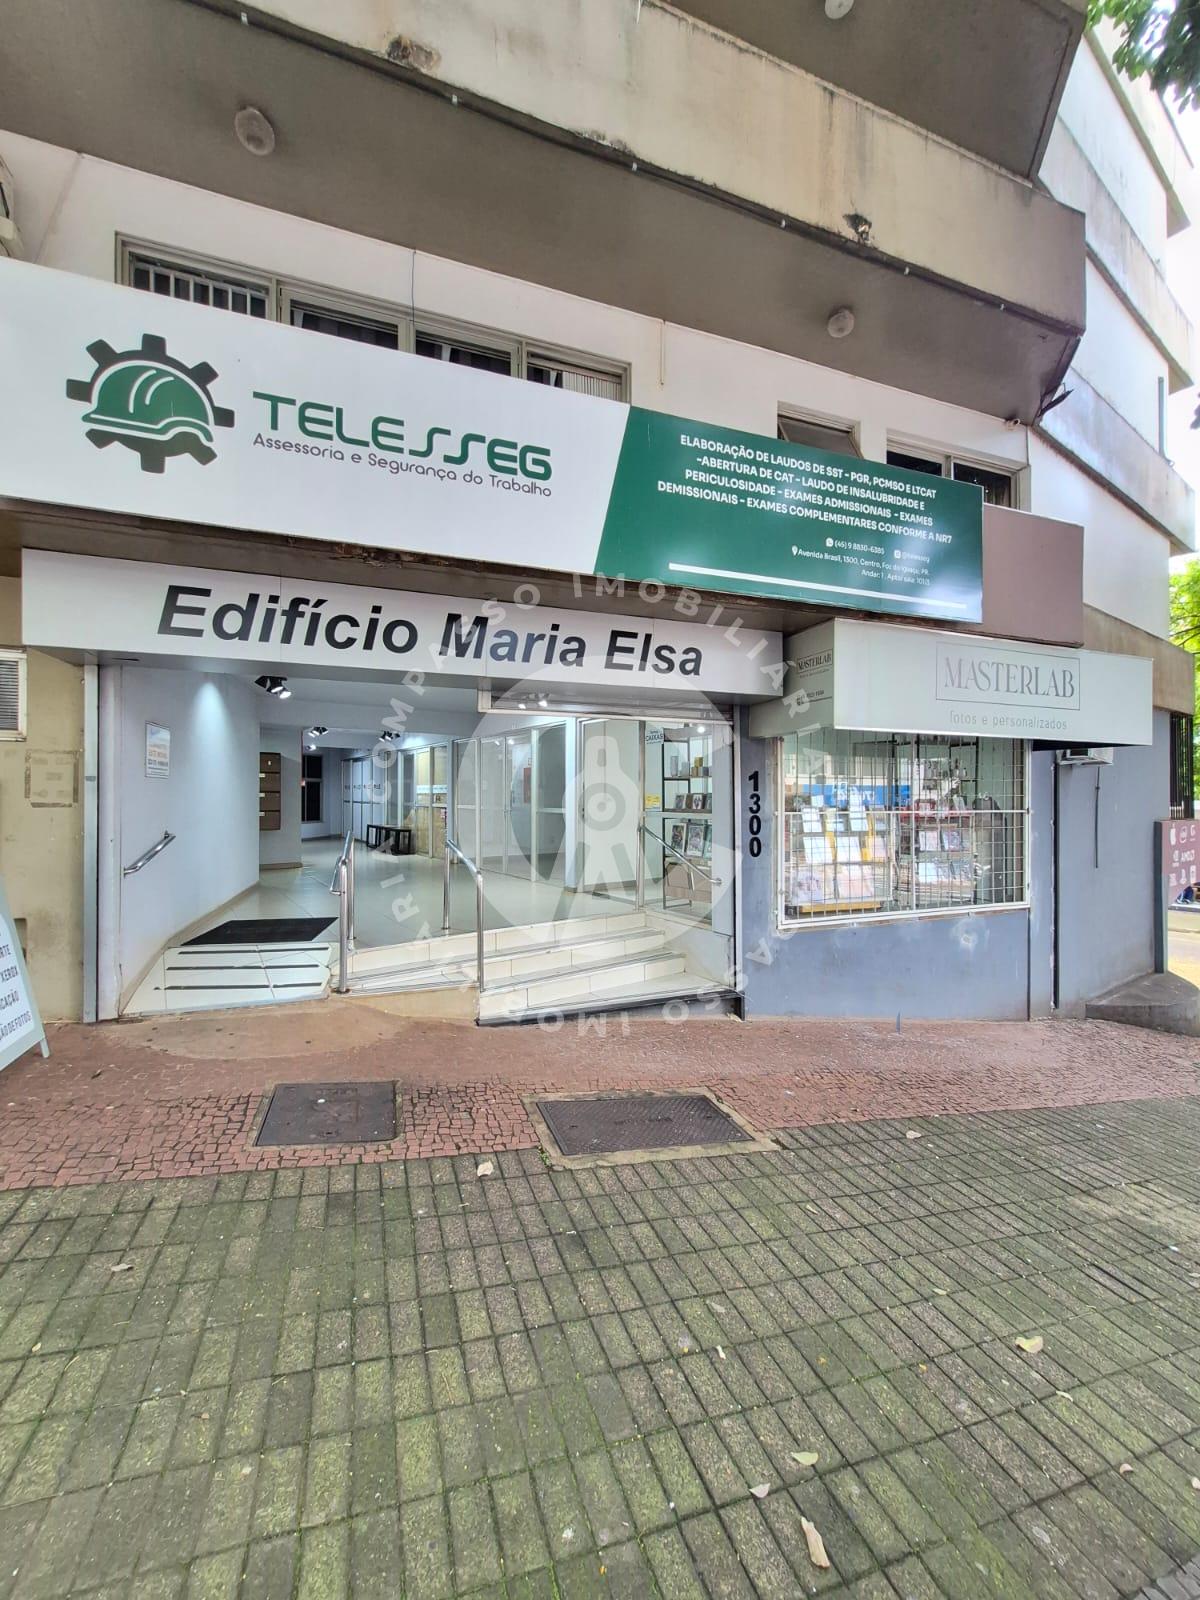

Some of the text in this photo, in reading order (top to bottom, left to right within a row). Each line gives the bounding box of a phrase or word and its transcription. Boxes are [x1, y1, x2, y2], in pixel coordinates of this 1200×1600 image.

[253, 391, 553, 482] TELESSEG
[253, 432, 552, 497] Assessoria e Segurança do Trabalho
[680, 434, 754, 459] ELABORAÇÃO
[756, 451, 769, 463] DE
[771, 453, 811, 473] LAUDOS
[813, 464, 825, 475] DE
[827, 466, 843, 478] SST
[851, 472, 872, 486] PGR,
[873, 477, 905, 492] PCMSO
[906, 484, 911, 492] E
[912, 485, 937, 499] LTCAT
[657, 481, 738, 505] DEMISSIONAIS
[747, 497, 788, 514] EXAMES
[789, 506, 877, 531] COMPLEMENTARES
[878, 521, 927, 541] CONFORME
[928, 531, 935, 540] A
[936, 532, 952, 544] NR7
[685, 469, 776, 496] PERICULOSIDADE
[784, 488, 823, 504] EXAMES
[825, 497, 892, 518] ADMISSIONAIS
[900, 511, 933, 527] EXAMES
[697, 456, 757, 476] -ABERTURA
[759, 468, 773, 480] DE
[774, 471, 794, 483] CAT
[802, 477, 835, 493] LAUDO
[836, 484, 848, 495] DE
[850, 487, 919, 508] INSALUBRIDADE
[920, 501, 925, 511] E
[798, 548, 824, 560] Avenida
[157, 584, 704, 676] Edifício Maria Elsa
[944, 656, 1075, 698] MASTERLAB
[950, 711, 1068, 730] fotos e personalizados
[748, 771, 762, 858] 1300
